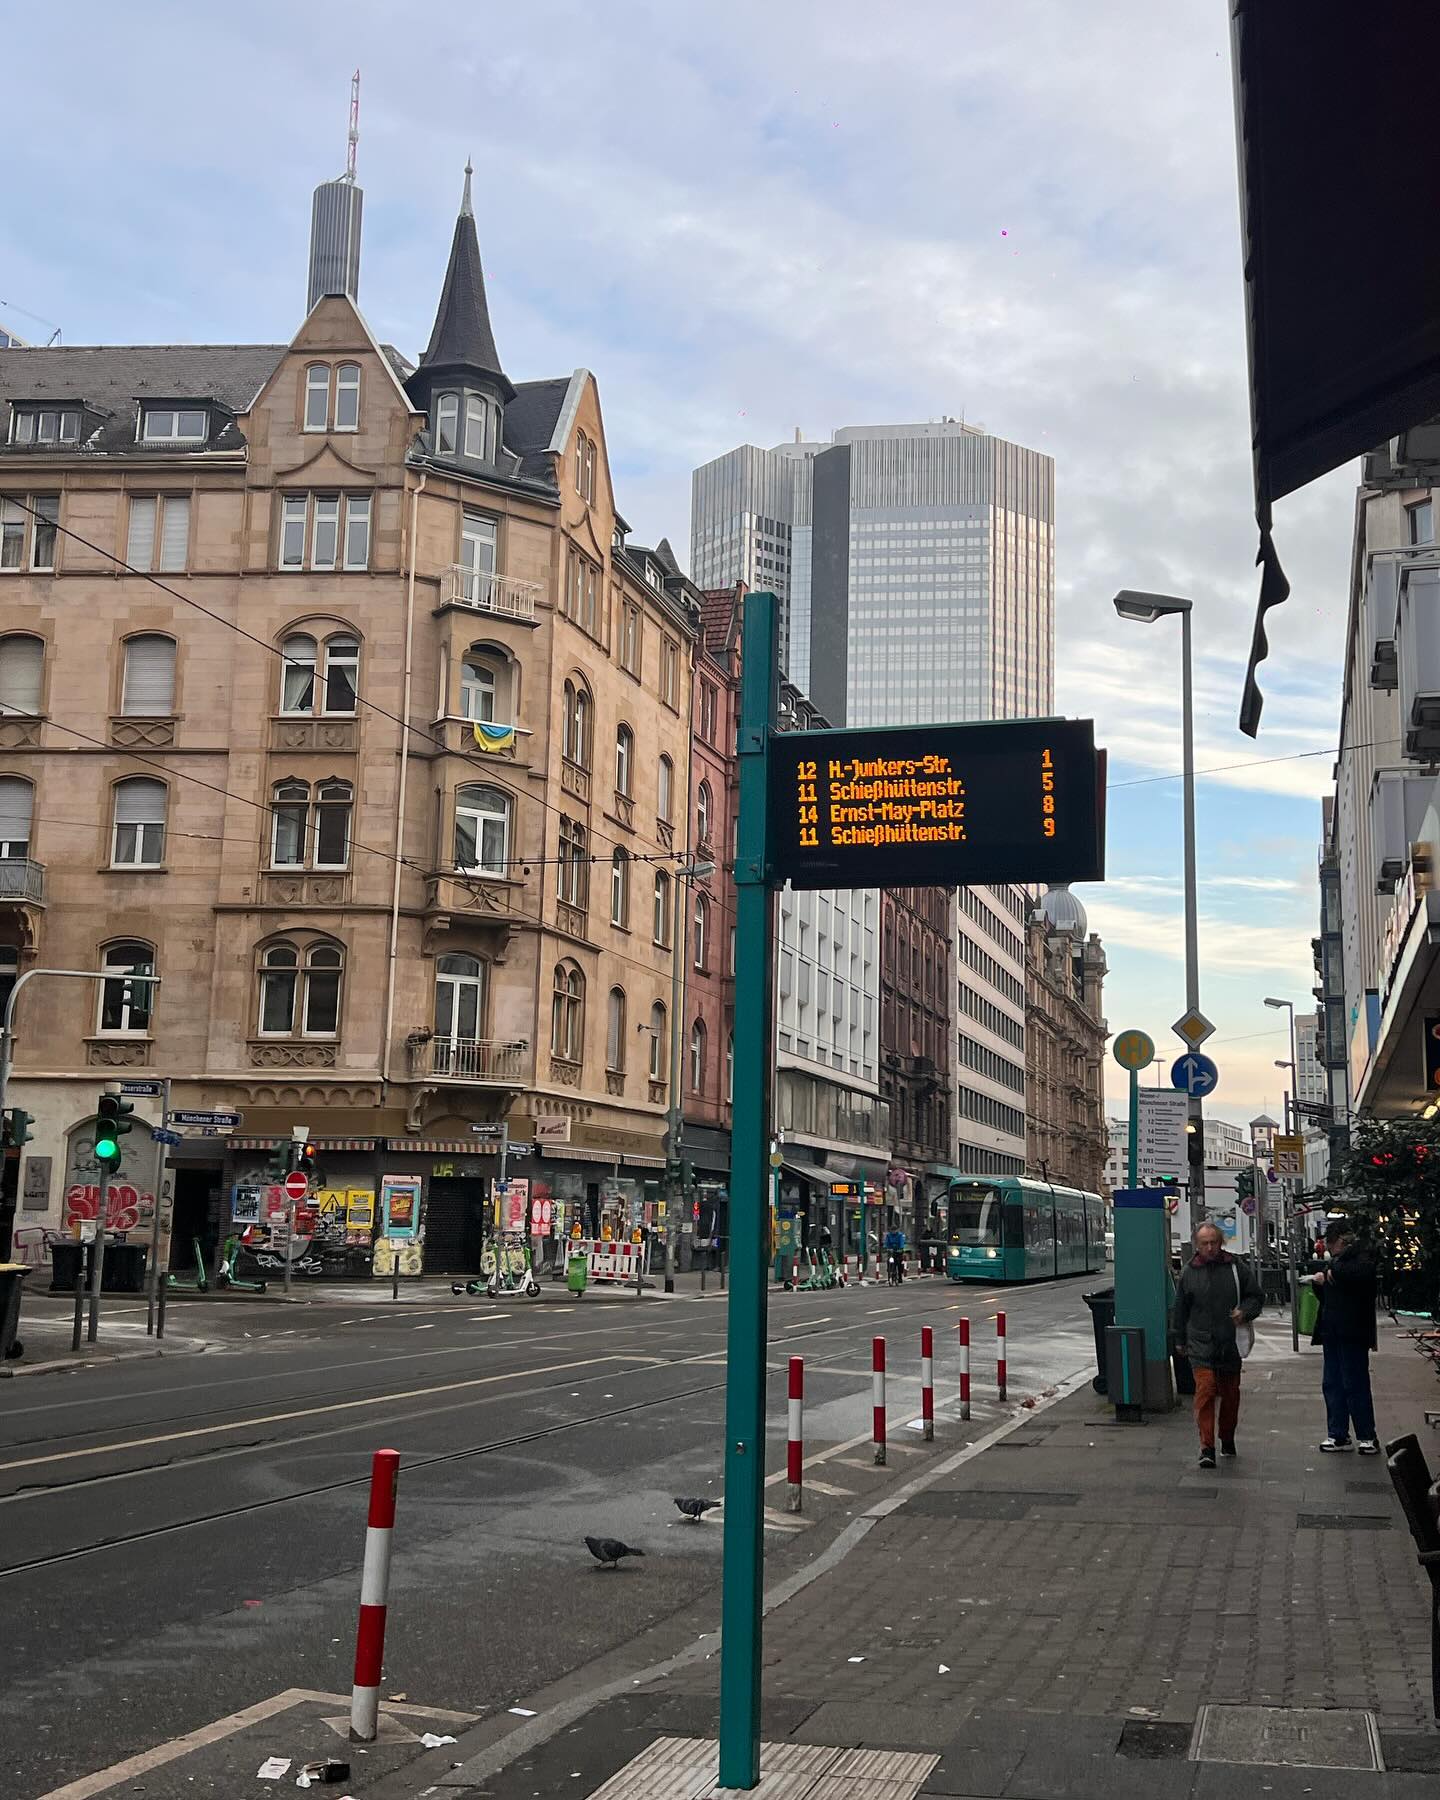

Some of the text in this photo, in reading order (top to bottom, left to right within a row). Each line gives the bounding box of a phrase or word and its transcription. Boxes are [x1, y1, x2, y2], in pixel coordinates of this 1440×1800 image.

[798, 749, 1053, 781] 12 H.-Junkers-Str. 1
[798, 772, 1054, 802] 11 Schießhüttenstr. 5
[799, 794, 1055, 824] 14 Ernst-May-Platz 8
[799, 817, 1056, 847] 11 Schießhüttenstr. 9
[213, 1116, 233, 1125] Straße
